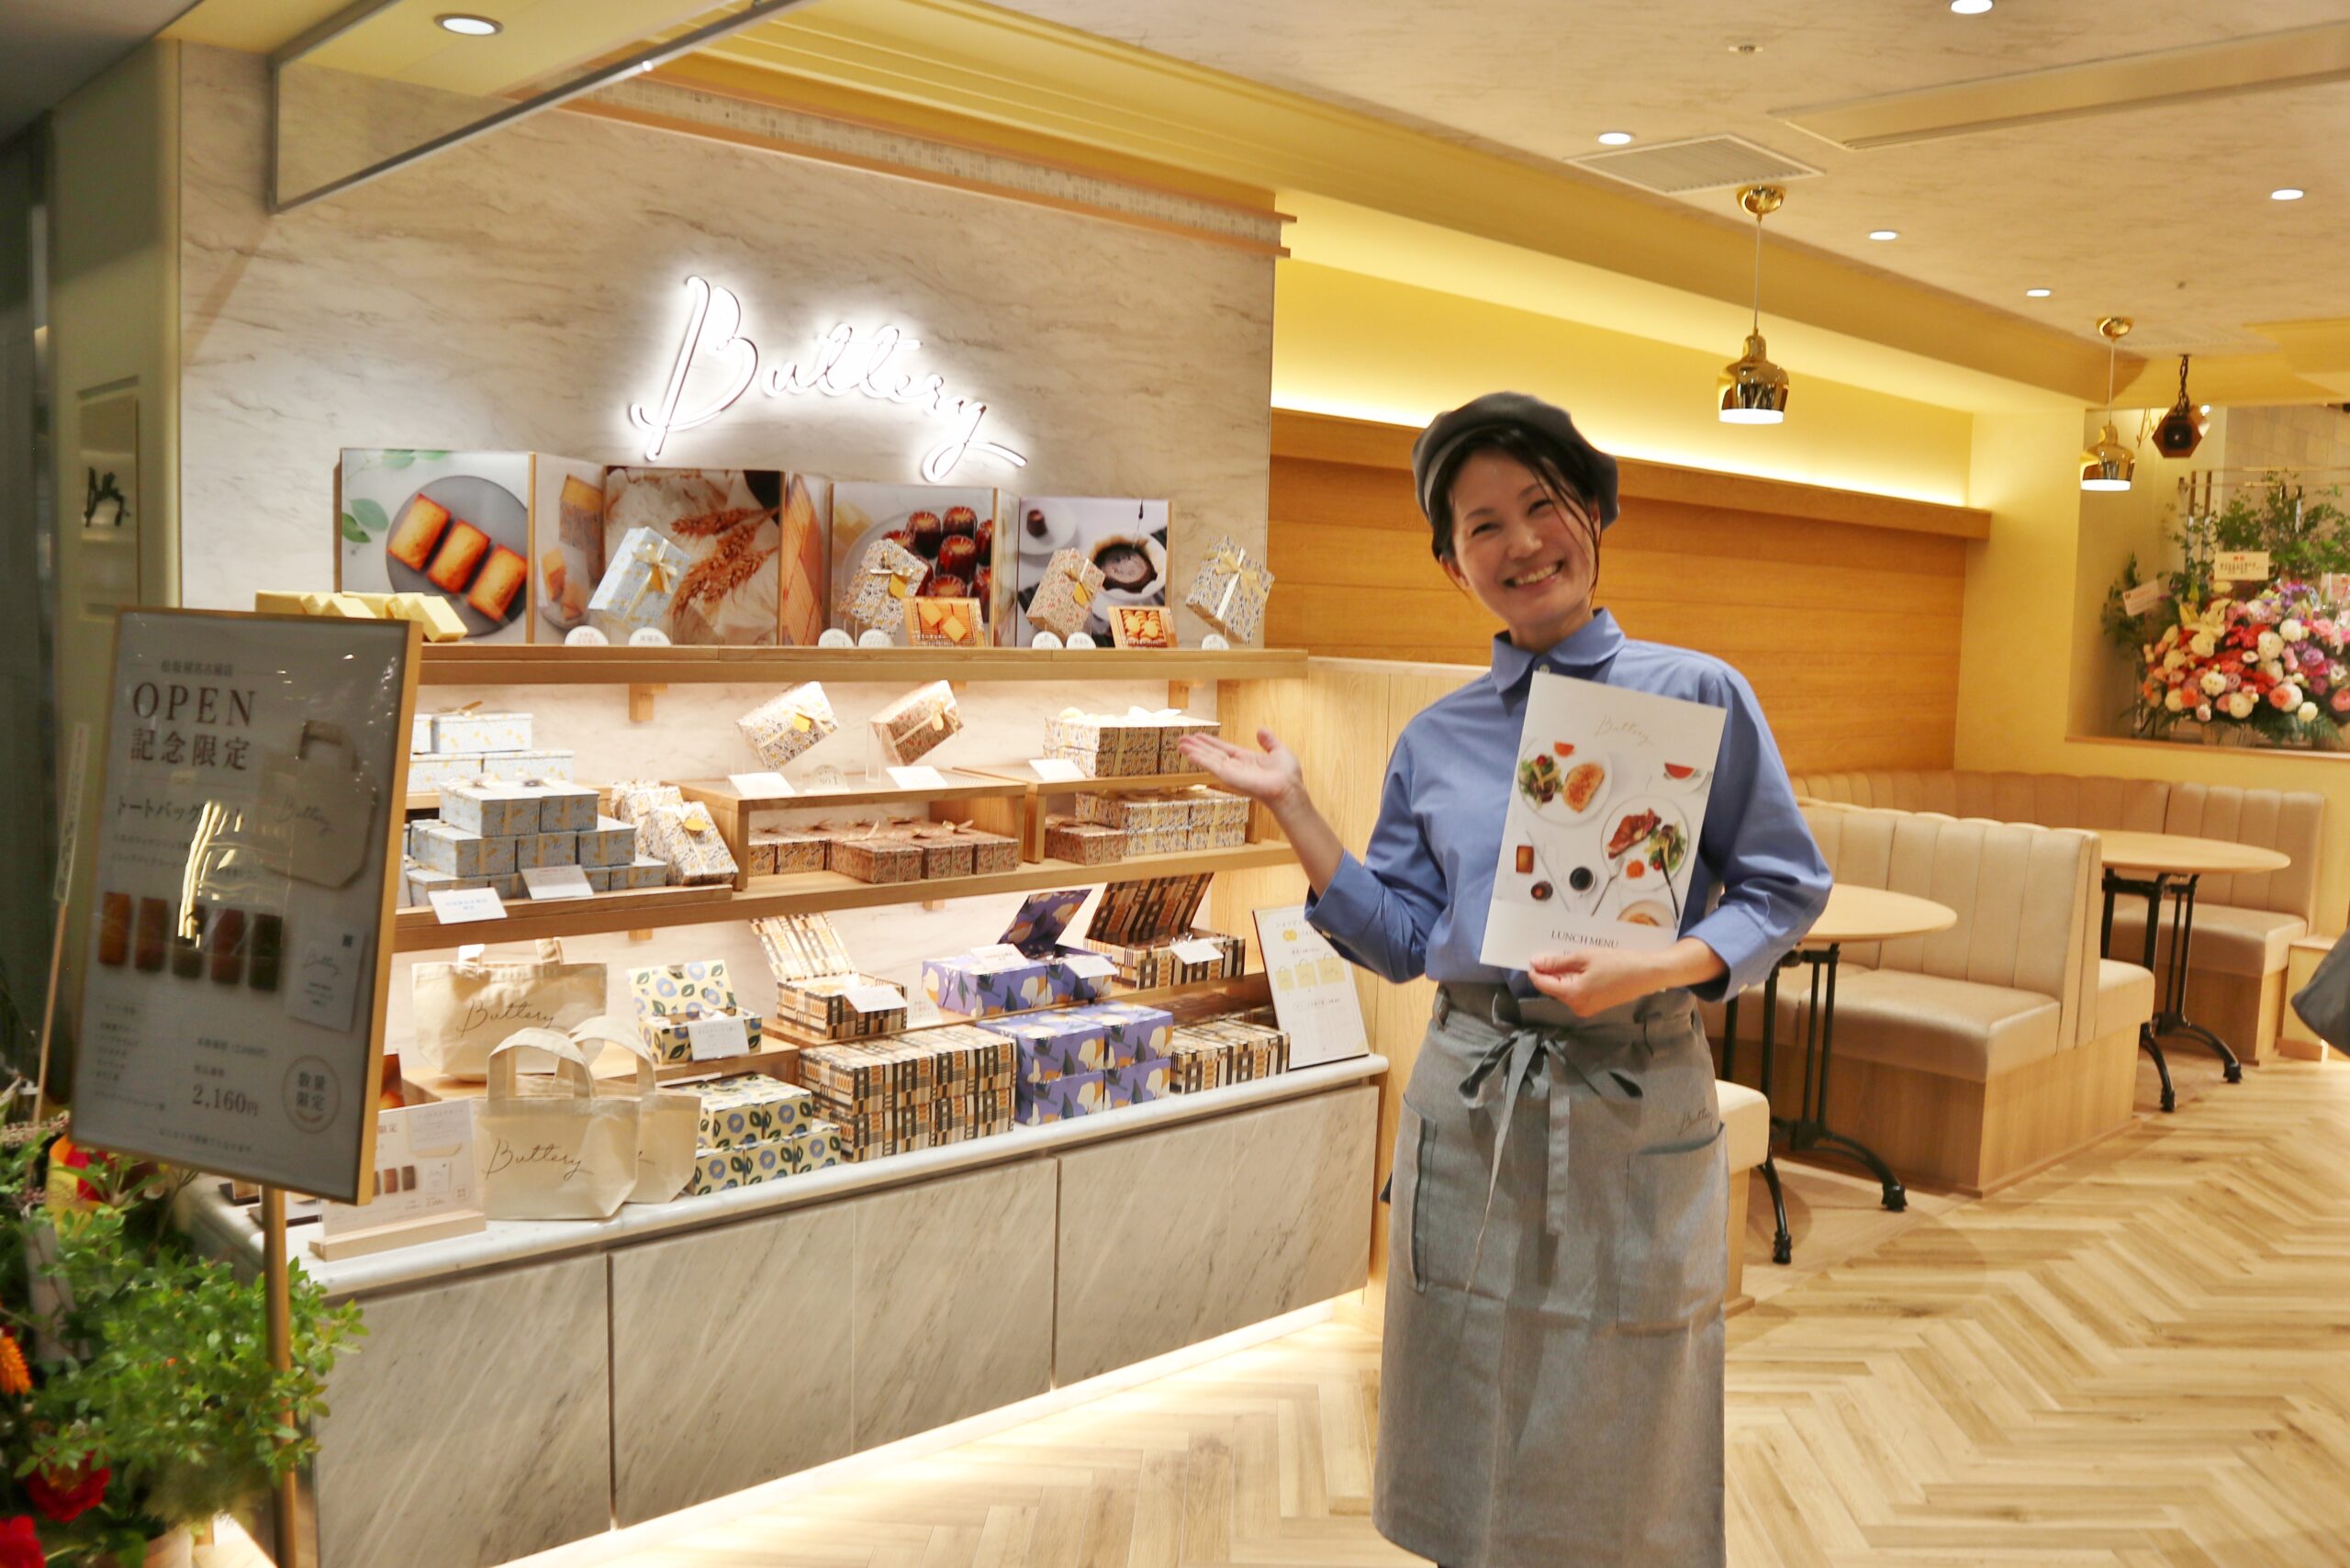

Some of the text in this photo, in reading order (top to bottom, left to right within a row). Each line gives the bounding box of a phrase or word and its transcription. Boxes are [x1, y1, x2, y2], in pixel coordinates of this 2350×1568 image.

[628, 274, 1028, 483] Buttery
[132, 682, 256, 727] OPEN
[130, 728, 251, 771] 記念限定
[1595, 713, 1656, 746] Buttery
[1550, 929, 1619, 949] LUNCH MENU
[456, 999, 566, 1037] Buttery
[192, 1083, 260, 1117] 2,160円
[480, 1137, 595, 1181] Buttery
